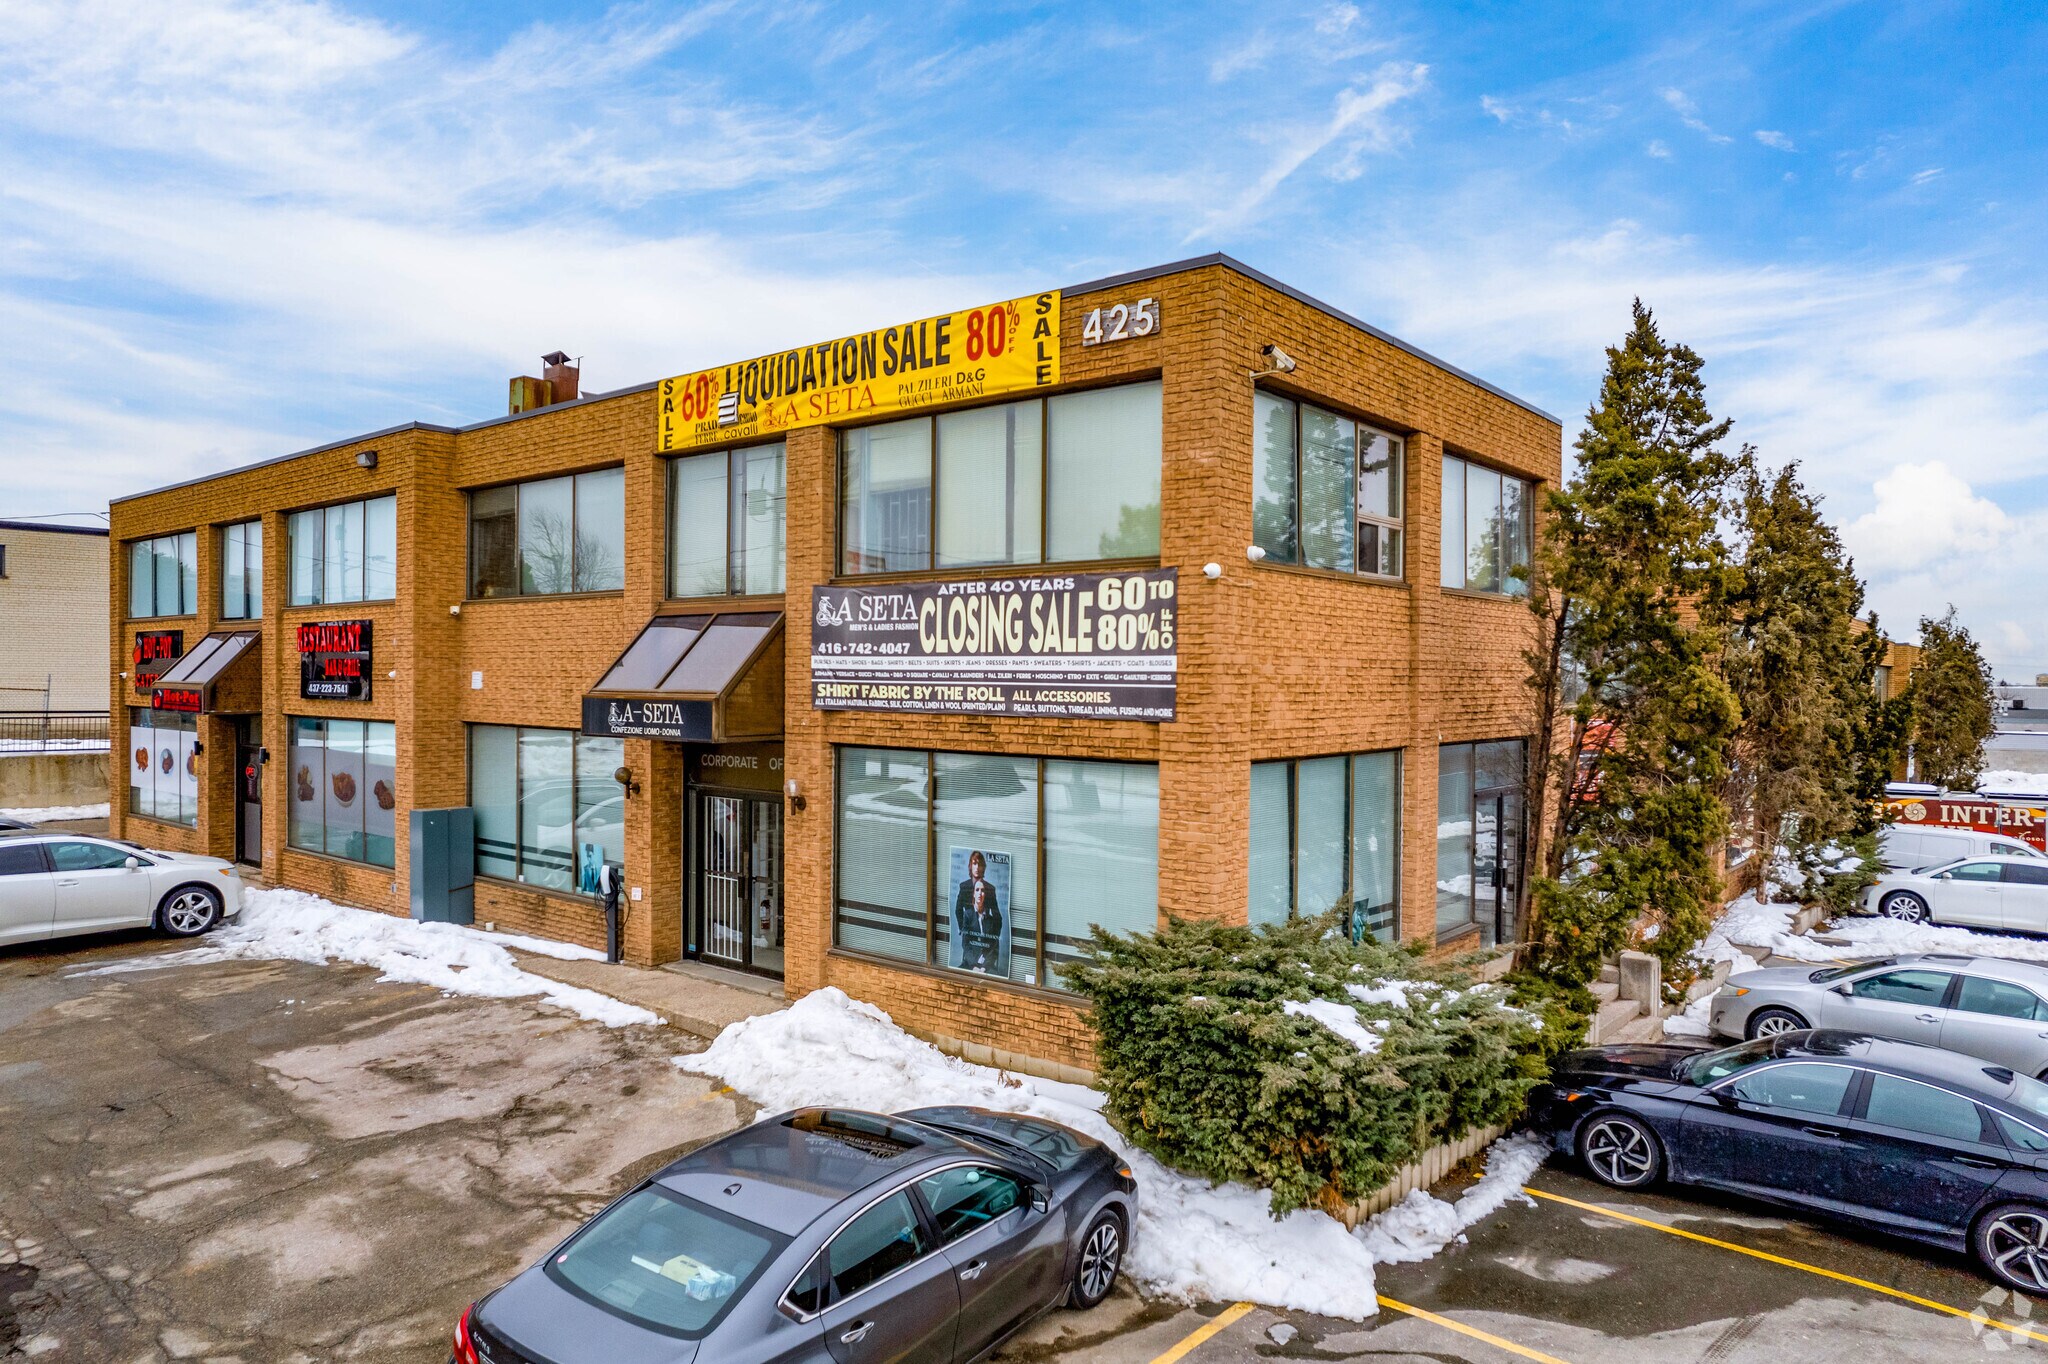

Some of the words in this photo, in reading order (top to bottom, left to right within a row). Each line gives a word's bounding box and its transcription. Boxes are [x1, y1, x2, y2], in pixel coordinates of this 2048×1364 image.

[966, 301, 1020, 362] 80%
[1083, 298, 1153, 343] 425
[1008, 327, 1017, 354] OFF
[1033, 294, 1053, 386] SALE
[725, 331, 877, 408] LIQUIDATION
[883, 316, 952, 376] SALE
[899, 384, 915, 396] PAL
[918, 375, 952, 390] ZILERI
[956, 368, 986, 385] D&G
[899, 393, 933, 408] GUCCI
[942, 382, 984, 402] ARMANI
[682, 369, 719, 422] 60%
[809, 384, 878, 419] SETA
[663, 378, 675, 450] SALE
[695, 420, 720, 433] PRAD
[724, 423, 759, 440] cavalli
[938, 583, 987, 596] AFTER
[990, 580, 1015, 592] 40
[1018, 578, 1075, 592] YEARS
[1098, 576, 1147, 611] 60
[1148, 580, 1174, 600] TO
[816, 596, 853, 627] LA
[858, 594, 919, 621] SETA
[919, 593, 1024, 654] CLOSING
[1028, 591, 1094, 653] SALE
[297, 624, 361, 652] RESTAURANT
[849, 623, 868, 632] MEN'S
[868, 623, 873, 631] &
[874, 623, 894, 631] LADIES
[895, 622, 919, 631] FASHION
[1097, 612, 1160, 651] 80%
[1160, 608, 1174, 650] OFF
[143, 636, 173, 659] HOT-POT
[163, 689, 199, 704] Hot-Pot
[308, 683, 348, 693] 437-223-7541
[817, 683, 859, 698] SHIRT
[861, 685, 911, 699] FABRIC
[913, 685, 933, 700] BY
[935, 686, 964, 700] THE
[967, 686, 1005, 702] ROLL
[1012, 689, 1032, 701] ALL
[1034, 690, 1111, 704] ACCESSORIES
[825, 698, 846, 706] ITALIAN
[902, 701, 925, 709] COTTON,
[925, 701, 940, 709] LINEN
[945, 702, 961, 710] WOOL
[1013, 703, 1037, 713] PEARLS,
[1038, 704, 1067, 714] BUTTONS,
[1068, 705, 1094, 715] THREAD,
[1095, 706, 1118, 716] LINING,
[1120, 706, 1143, 716] FUSING
[1143, 708, 1154, 716] AND
[1155, 708, 1173, 717] MORE
[611, 726, 643, 735] CONFEZIONE
[644, 727, 682, 736] UOMO-DONNA
[701, 754, 758, 769] CORPORATE
[1940, 804, 2045, 827] INTER-
[988, 853, 995, 862] LA
[995, 855, 1009, 864] SETA
